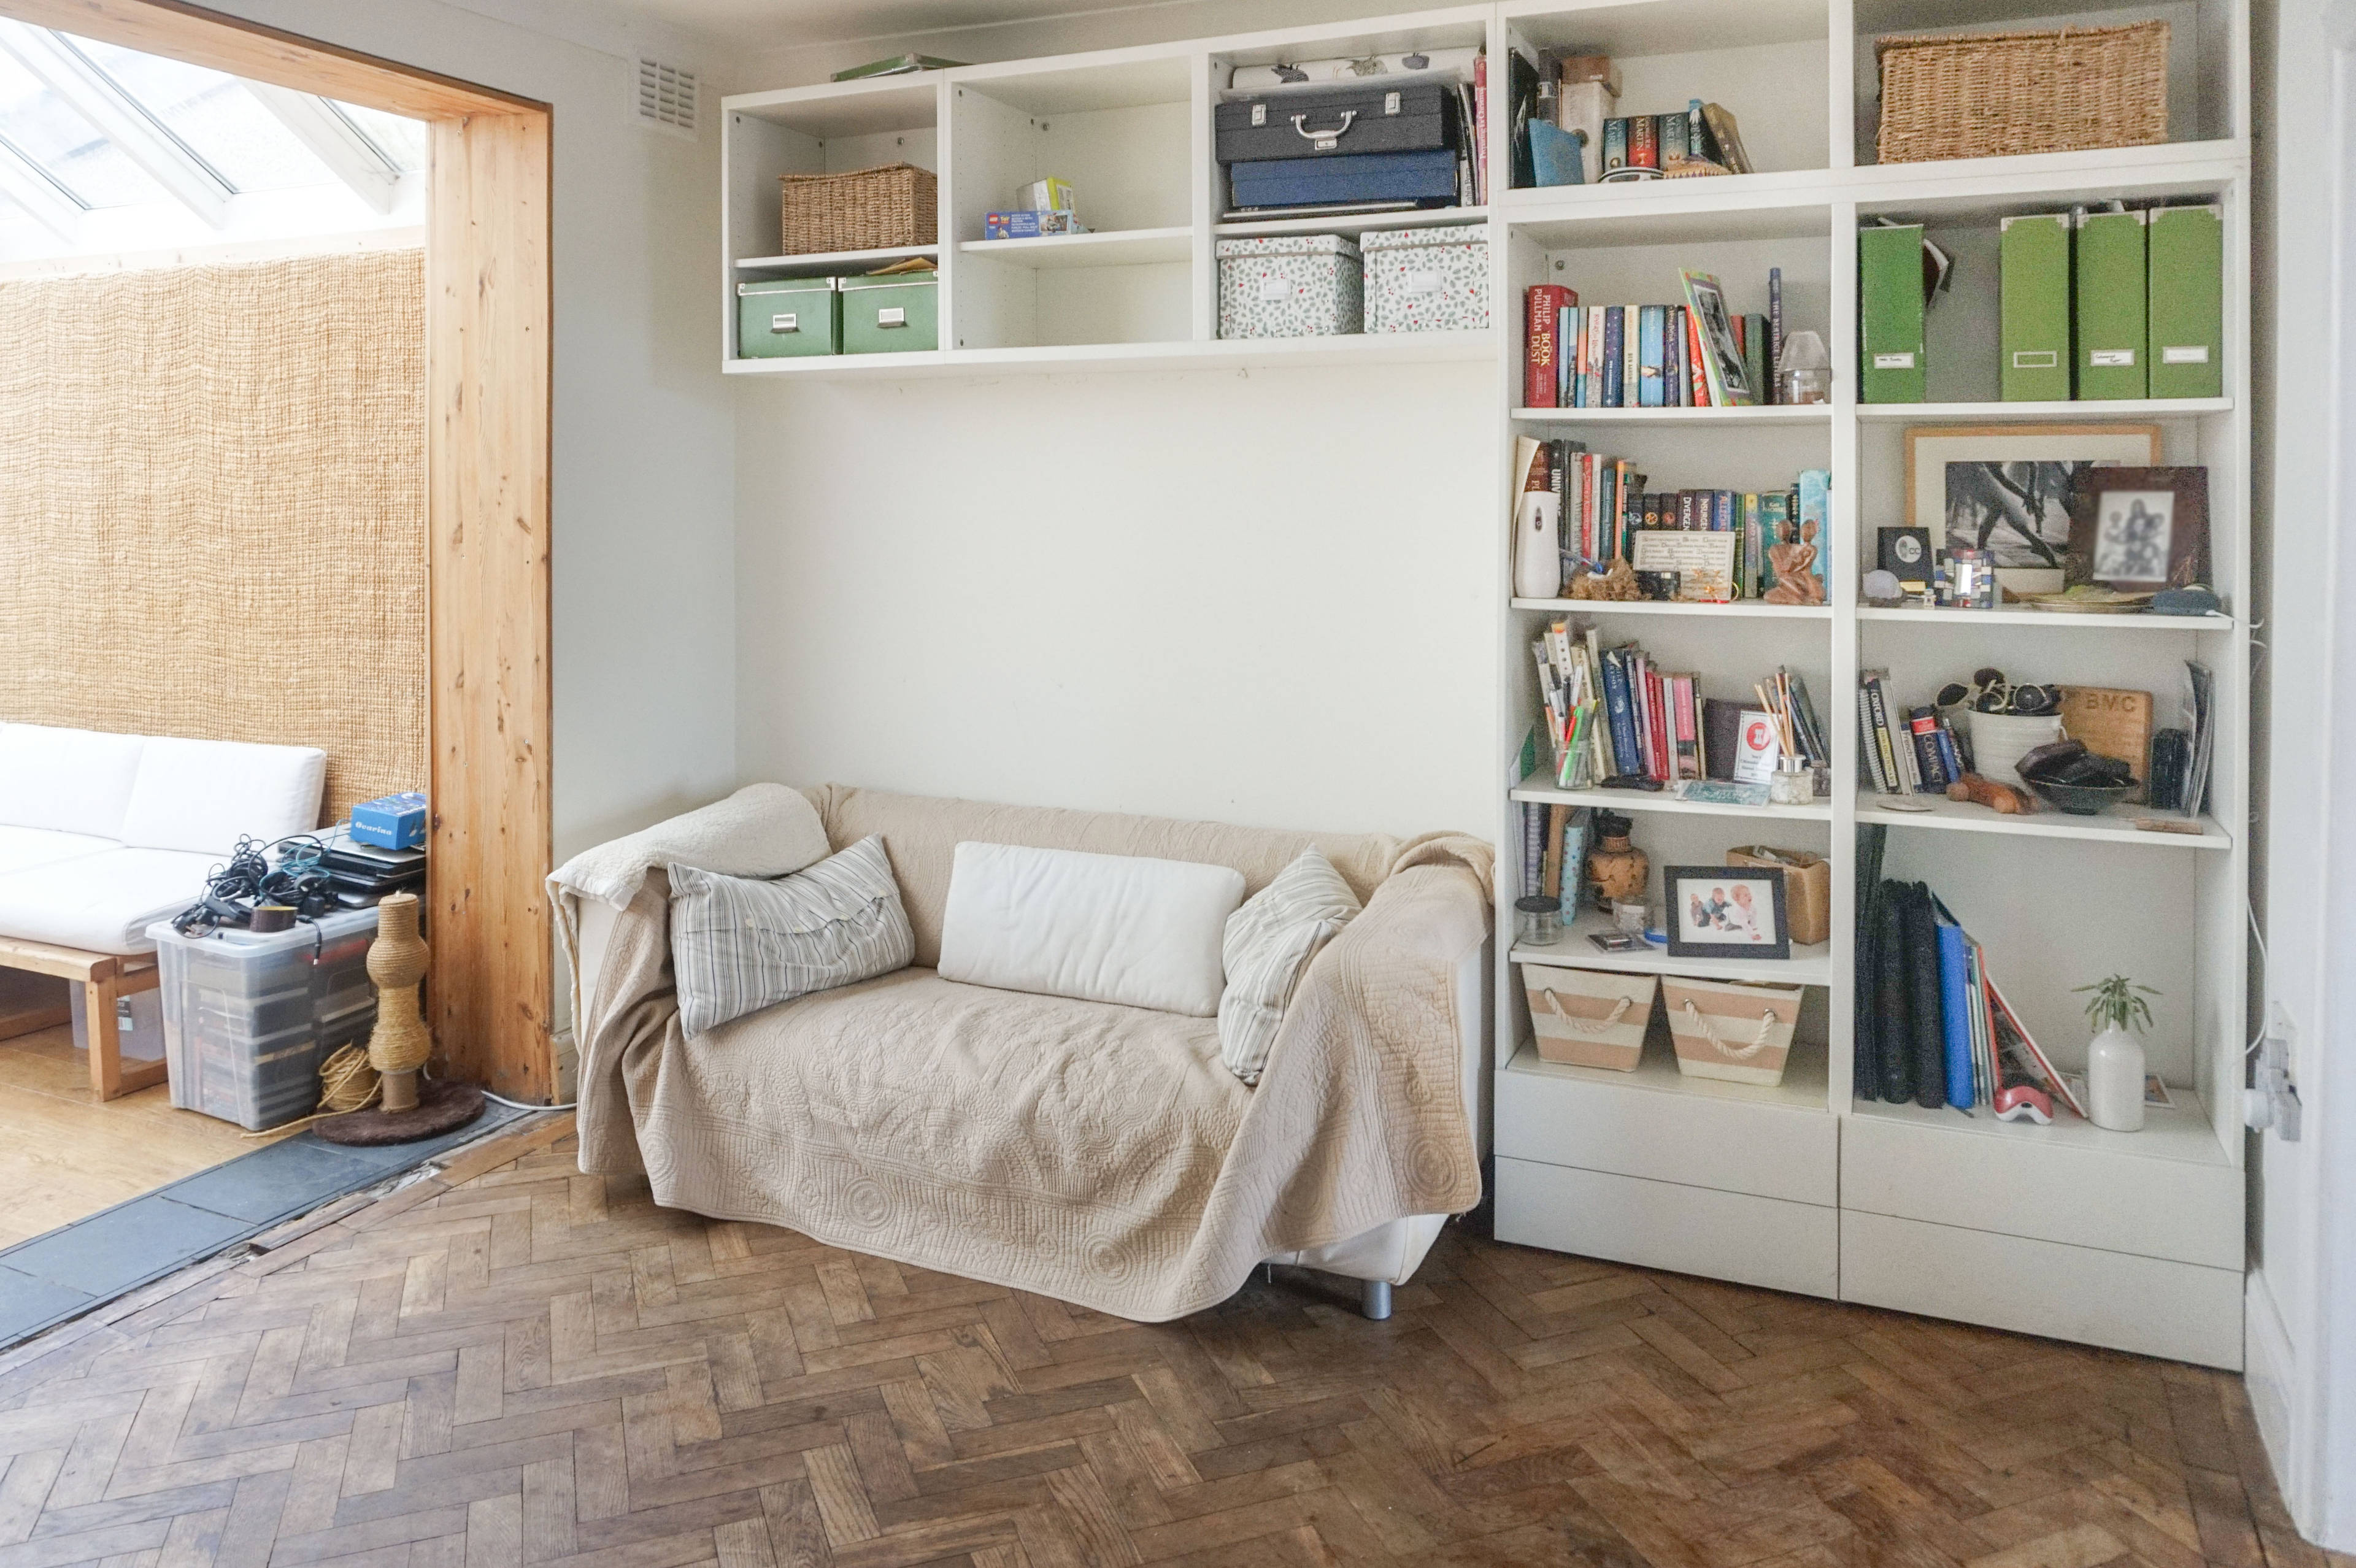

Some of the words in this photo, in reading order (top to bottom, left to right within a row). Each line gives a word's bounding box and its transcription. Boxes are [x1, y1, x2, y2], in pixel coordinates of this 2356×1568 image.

[1636, 118, 1645, 151] MARTIN
[1531, 335, 1541, 364] DUST
[1541, 332, 1551, 366] BOOK
[1683, 497, 1692, 530] DIVERGEN
[1700, 498, 1709, 531] INSURGEN
[1719, 496, 1728, 531] ALLEGIAN
[1870, 692, 1884, 726] OXFORD
[2085, 693, 2136, 712] BMC
[1903, 732, 1915, 756] French
[1924, 734, 1942, 783] COMPACT
[355, 821, 393, 836] Ocarina
